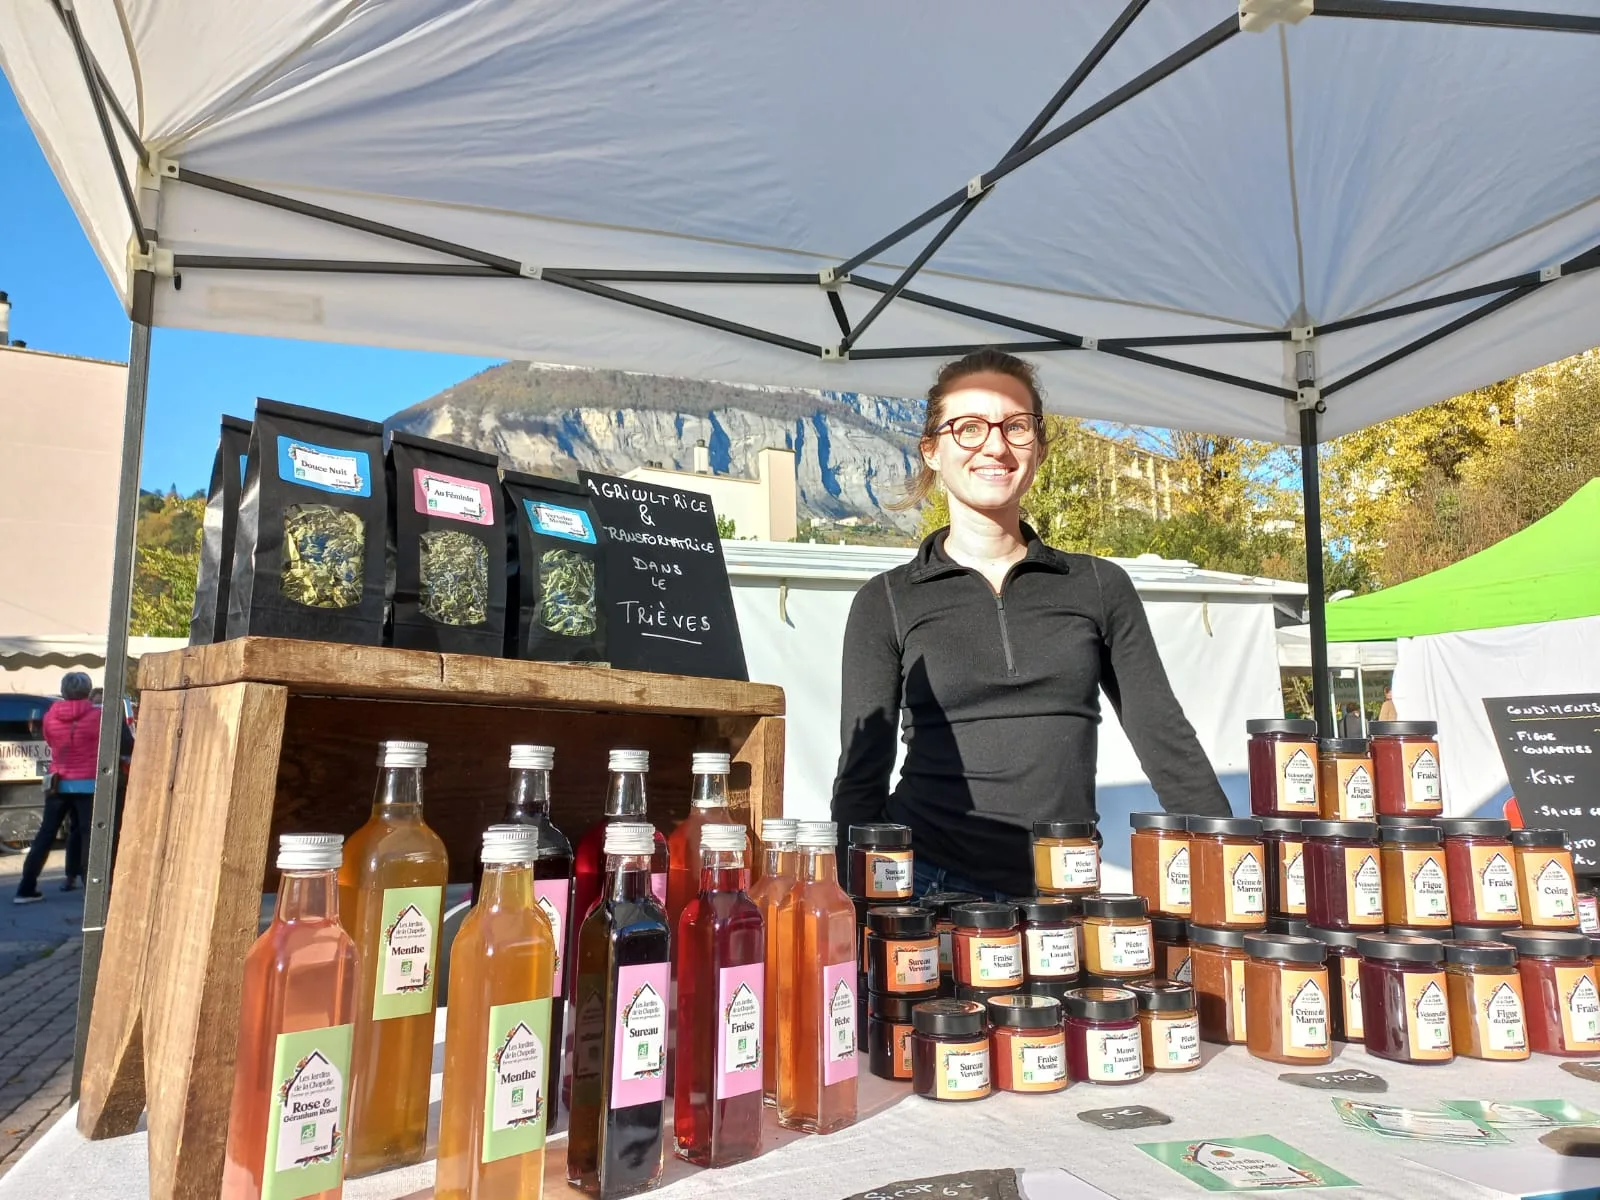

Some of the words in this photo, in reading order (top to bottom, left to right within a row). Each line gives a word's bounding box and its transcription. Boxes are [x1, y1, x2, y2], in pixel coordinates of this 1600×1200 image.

[301, 460, 328, 472] Douce
[329, 467, 348, 476] Nuit
[446, 491, 474, 502] Féminin
[588, 478, 707, 512] AGRICULTRICE
[639, 504, 655, 526] &
[632, 556, 682, 575] DANS
[652, 577, 666, 590] LE
[616, 601, 710, 632] TRIÈVES
[1516, 731, 1556, 741] FIGUE
[1540, 806, 1582, 817] SAUCE
[1423, 881, 1442, 890] Figue
[1489, 878, 1512, 886] Fraise
[1544, 887, 1568, 896] Coing
[392, 945, 424, 956] Menthe
[1497, 1010, 1517, 1019] Figue
[835, 1016, 850, 1026] Pêche
[630, 1027, 658, 1038] Sureau
[732, 1021, 755, 1033] Fraise
[518, 1041, 534, 1049] Jardins
[517, 1048, 536, 1057] Chapelle
[300, 1075, 310, 1083] Les
[311, 1072, 330, 1081] Jardins
[501, 1070, 536, 1085] Menthe
[309, 1079, 333, 1089] Chapelle
[293, 1100, 320, 1114] Rose
[323, 1098, 330, 1107] &
[284, 1111, 318, 1122] Géranium
[319, 1106, 338, 1116] Rosat
